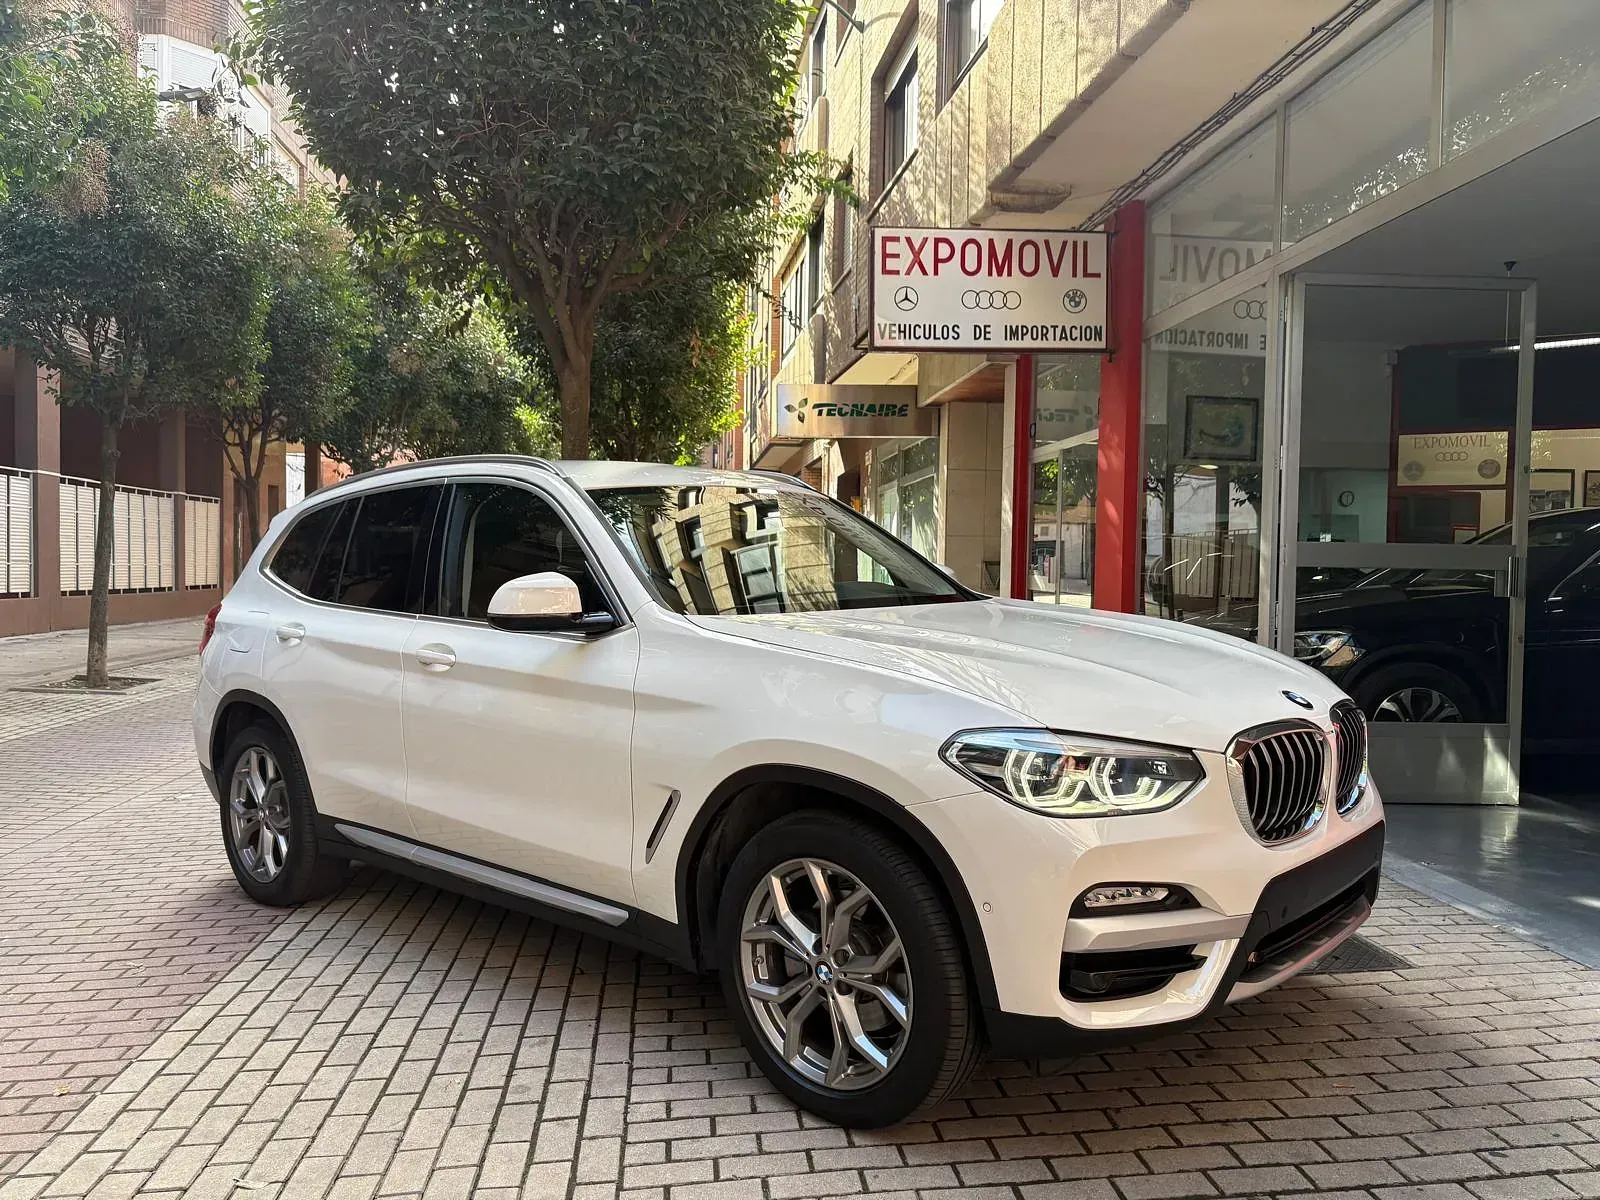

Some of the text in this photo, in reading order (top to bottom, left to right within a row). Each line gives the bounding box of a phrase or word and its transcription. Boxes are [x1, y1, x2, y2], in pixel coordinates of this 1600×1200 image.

[881, 236, 1101, 278] EXPOMOVIL
[877, 323, 1103, 342] VEHICULOS DE IMPORTACION
[812, 402, 909, 417] TECNAIRE
[1414, 434, 1490, 449] EXPOMOVIL
